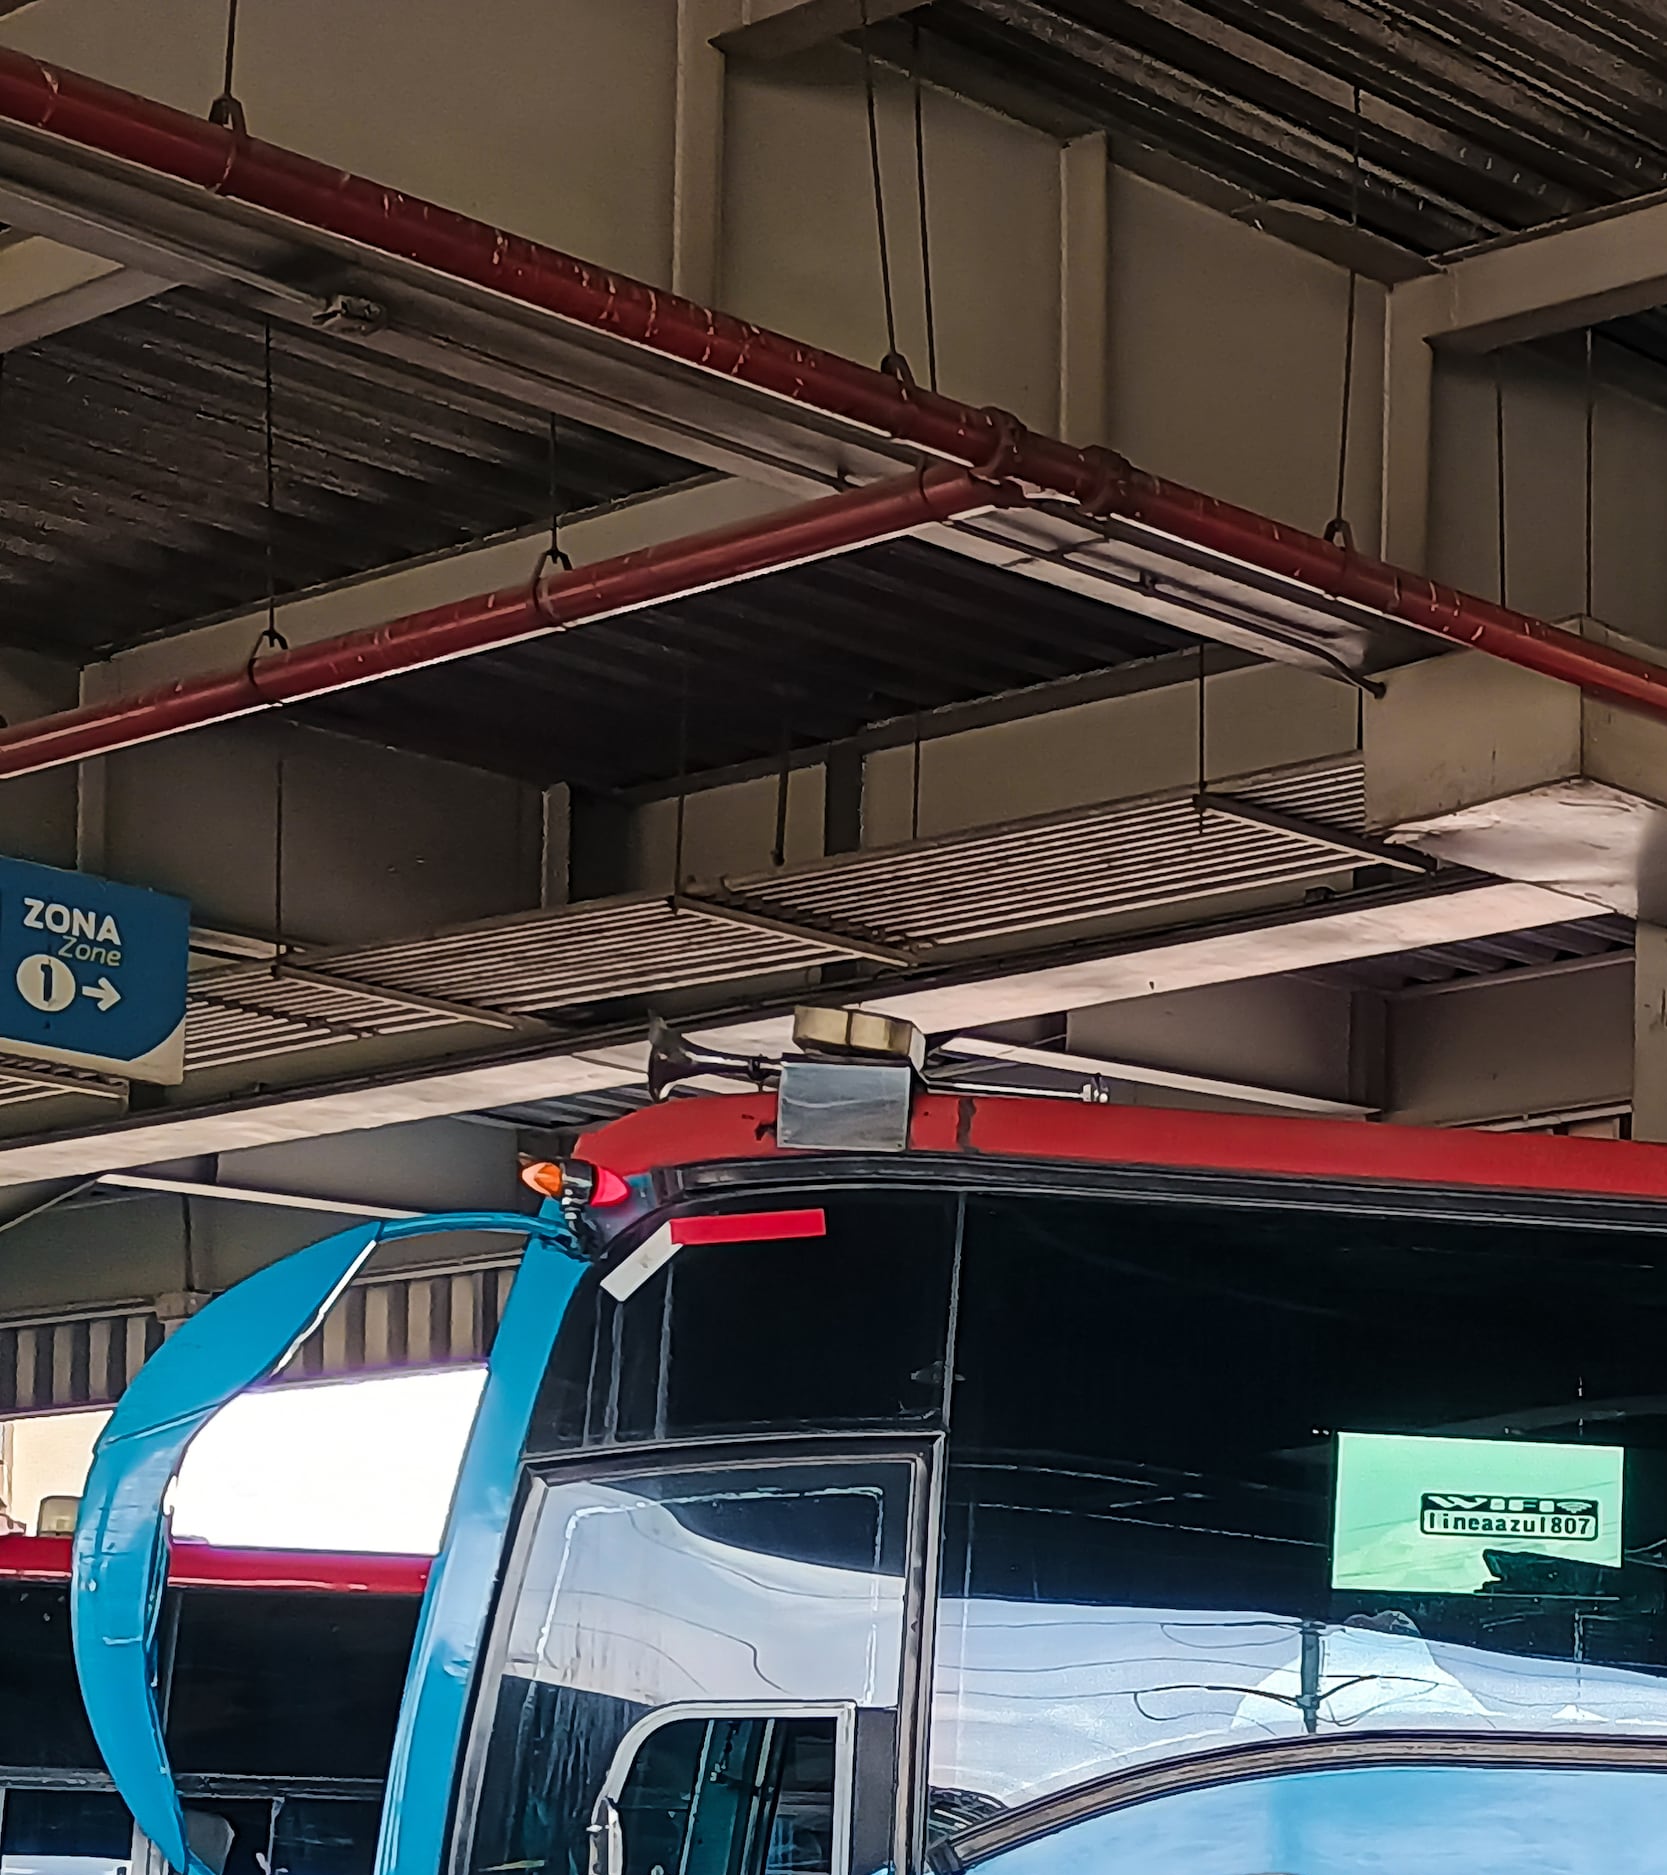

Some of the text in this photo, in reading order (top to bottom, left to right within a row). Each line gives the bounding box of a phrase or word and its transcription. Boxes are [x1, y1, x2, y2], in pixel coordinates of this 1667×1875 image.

[23, 897, 122, 946] ZONA
[58, 936, 122, 967] Zone
[1428, 1514, 1591, 1535] lineaazul807
